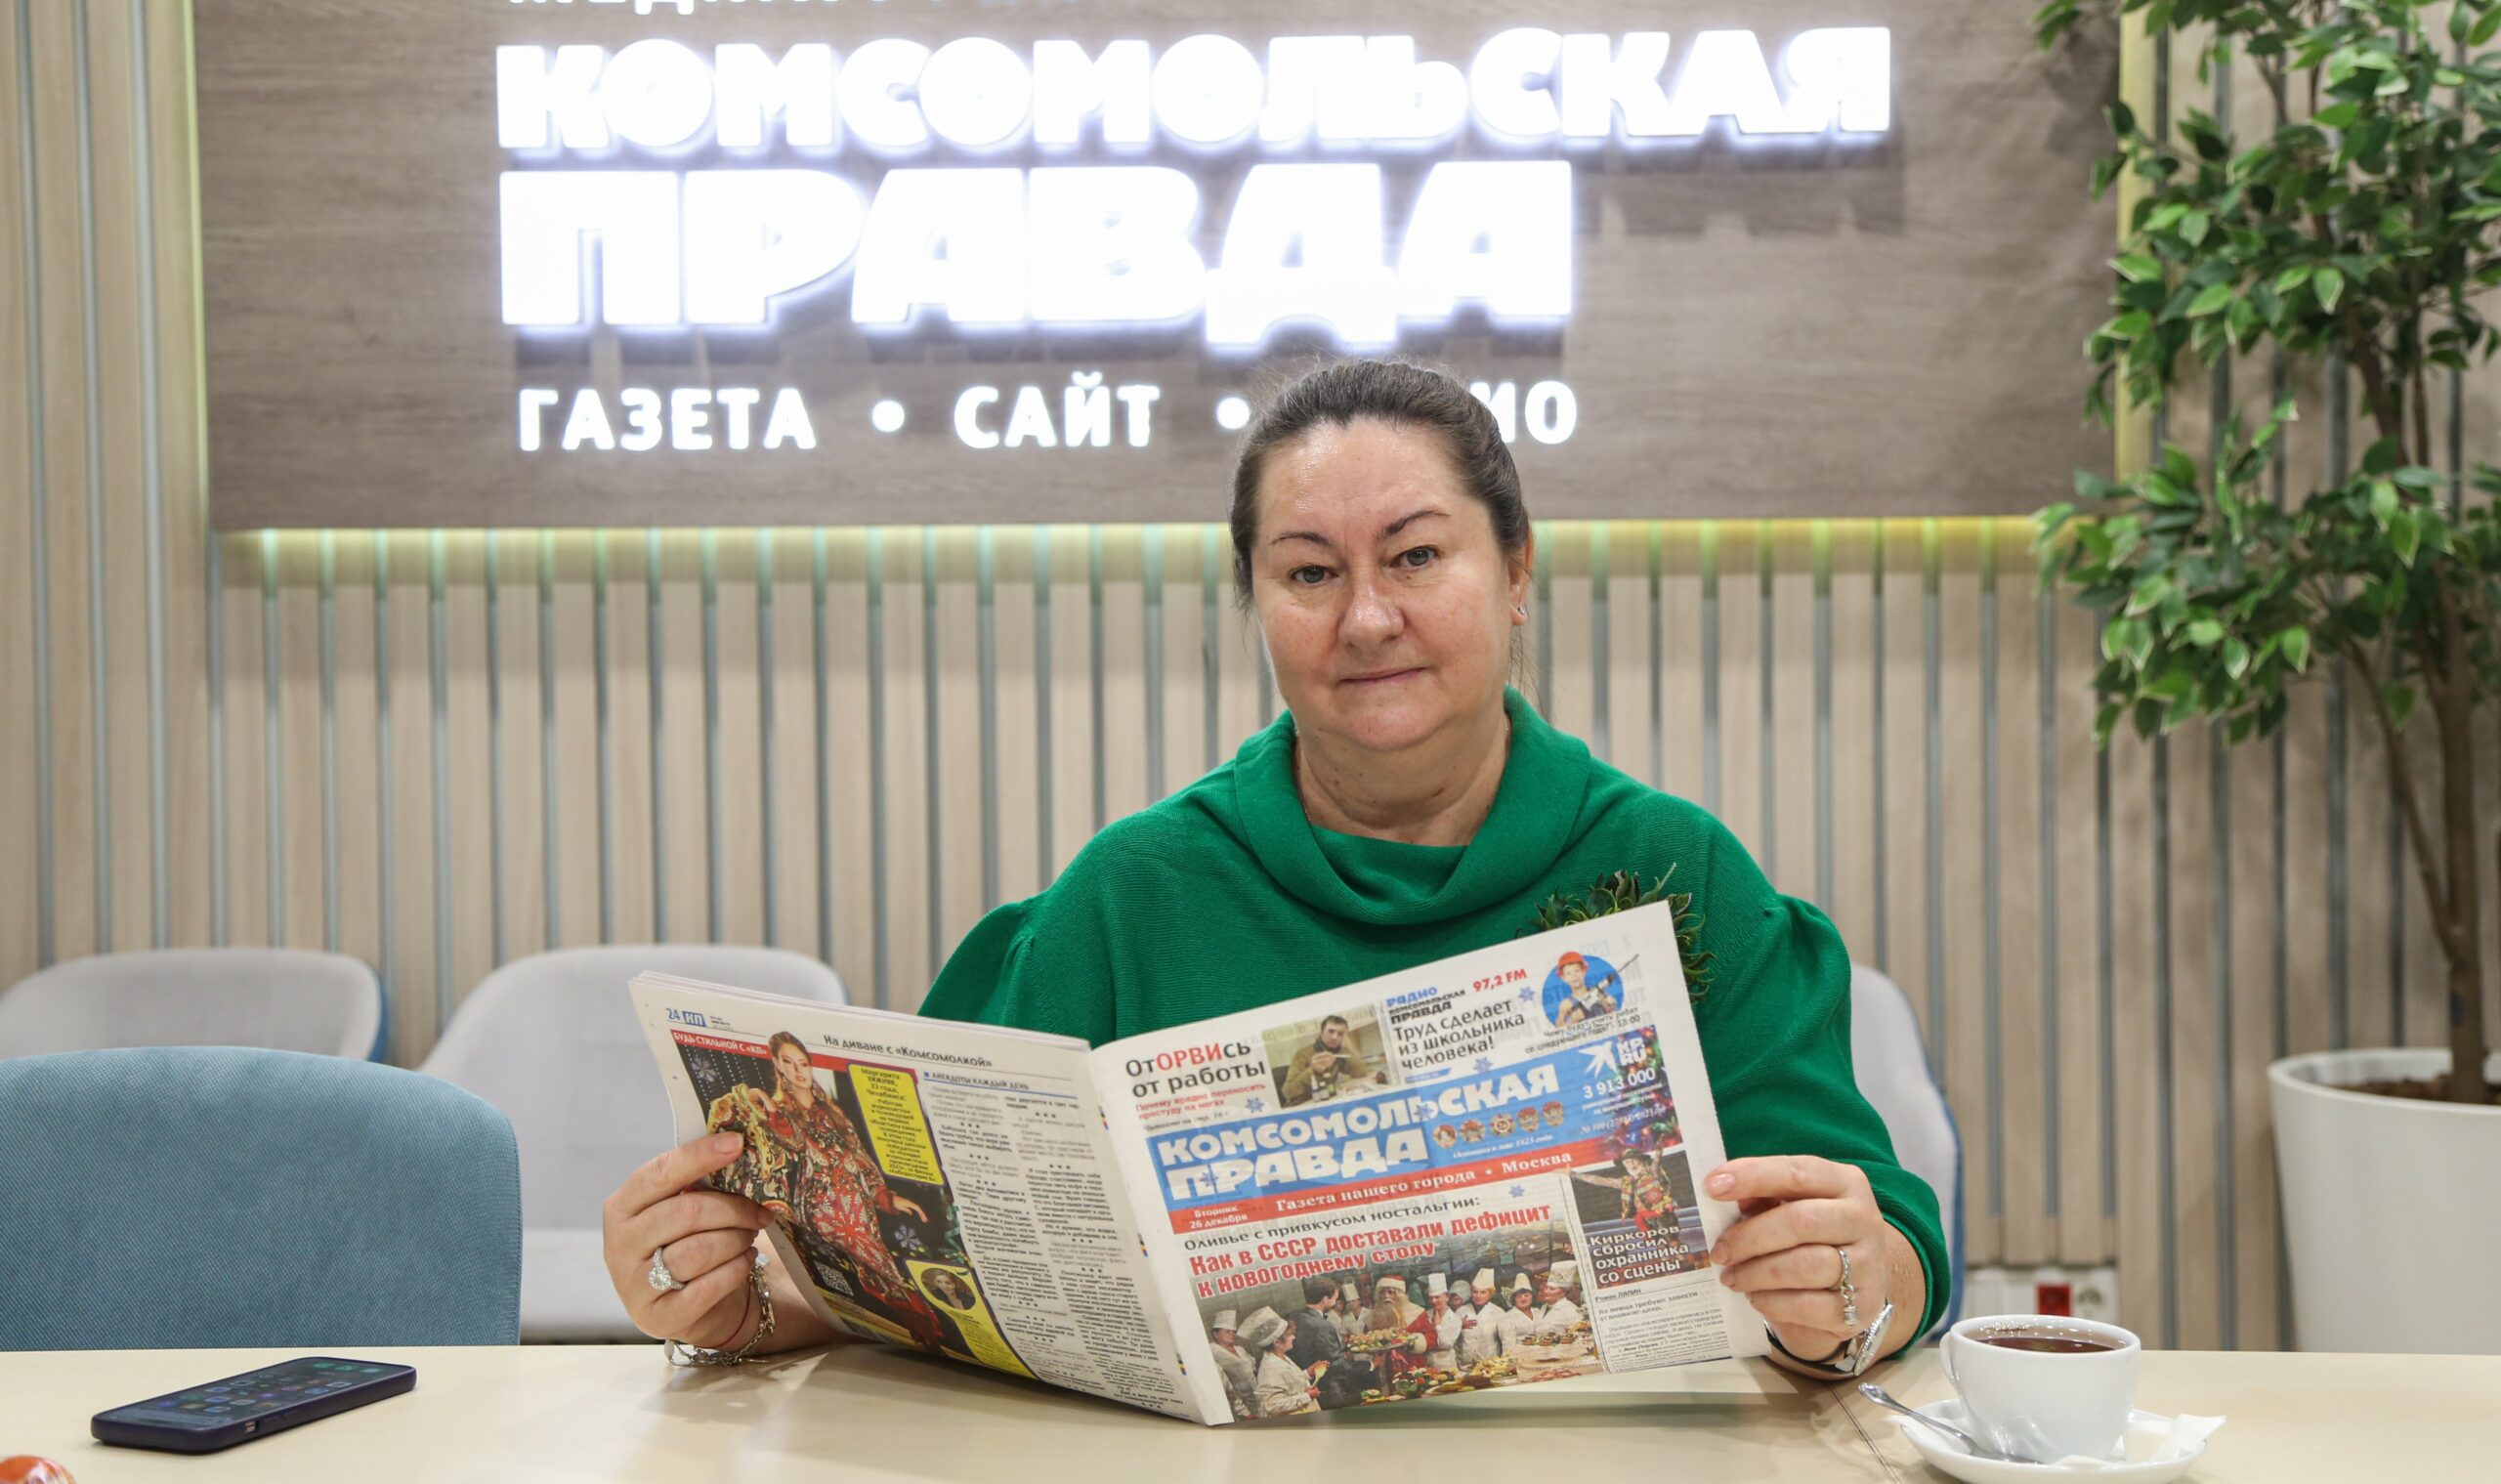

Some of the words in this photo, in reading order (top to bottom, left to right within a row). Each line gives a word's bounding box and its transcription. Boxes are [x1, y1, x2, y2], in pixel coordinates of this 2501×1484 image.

[496, 27, 1890, 148] КОМСОМОЛЬСКАЯ
[499, 160, 1572, 344] ПРАВДА
[520, 388, 817, 451] ГАЗЕТА
[954, 371, 1161, 448] САЙТ
[1472, 975, 1505, 994] 97,2
[1505, 968, 1528, 983] FM
[666, 1008, 681, 1021] 24
[685, 1012, 704, 1026] КП
[1394, 1020, 1438, 1042] Труд
[1440, 999, 1512, 1029] сделает
[672, 1032, 696, 1043] БУДЬ
[696, 1036, 739, 1051] СТИЛЬНОЙ
[824, 1035, 839, 1046] На
[842, 1039, 884, 1053] диване
[887, 1045, 894, 1055] с
[896, 1046, 993, 1068] «Комсомолкой»
[1399, 1042, 1419, 1057] из
[1423, 1014, 1525, 1049] школьника
[1125, 1041, 1251, 1077] ОтОРВИсь
[1401, 1038, 1495, 1071] человека!
[1132, 1081, 1160, 1098] от
[1166, 1061, 1266, 1094] работы
[1583, 1084, 1593, 1099] 3
[1595, 1076, 1625, 1095] 913
[1628, 1067, 1657, 1086] 000
[1135, 1099, 1171, 1112] Почему
[1210, 1083, 1266, 1098] переносить
[1138, 1106, 1181, 1121] простуду
[1157, 1063, 1560, 1166] КОМСОМОЛЬСКАЯ
[1166, 1129, 1429, 1201] ПРАВДА
[1275, 1195, 1336, 1213] Газета
[1340, 1183, 1409, 1205] нашего
[1413, 1169, 1476, 1191] города
[1501, 1151, 1573, 1173] Москва
[1184, 1233, 1250, 1251] Оливье
[1254, 1230, 1263, 1240] с
[1268, 1214, 1367, 1241] привкусом
[1371, 1196, 1481, 1226] ностальгии:
[1190, 1219, 1203, 1229] 26
[1205, 1213, 1249, 1228] декабря
[1194, 1205, 1239, 1218] Вторник
[1189, 1253, 1233, 1277] Как
[1238, 1248, 1253, 1266] в
[1256, 1239, 1318, 1264] СССР
[1325, 1222, 1445, 1255] доставали
[1450, 1205, 1551, 1237] дефицит
[1589, 1225, 1680, 1247] Киркоров
[1592, 1238, 1668, 1258] сбросил
[1217, 1253, 1365, 1293] новогоднему
[1372, 1242, 1436, 1264] столу
[1595, 1244, 1689, 1270] охранника
[1598, 1272, 1619, 1285] со
[1623, 1259, 1681, 1281] сцены
